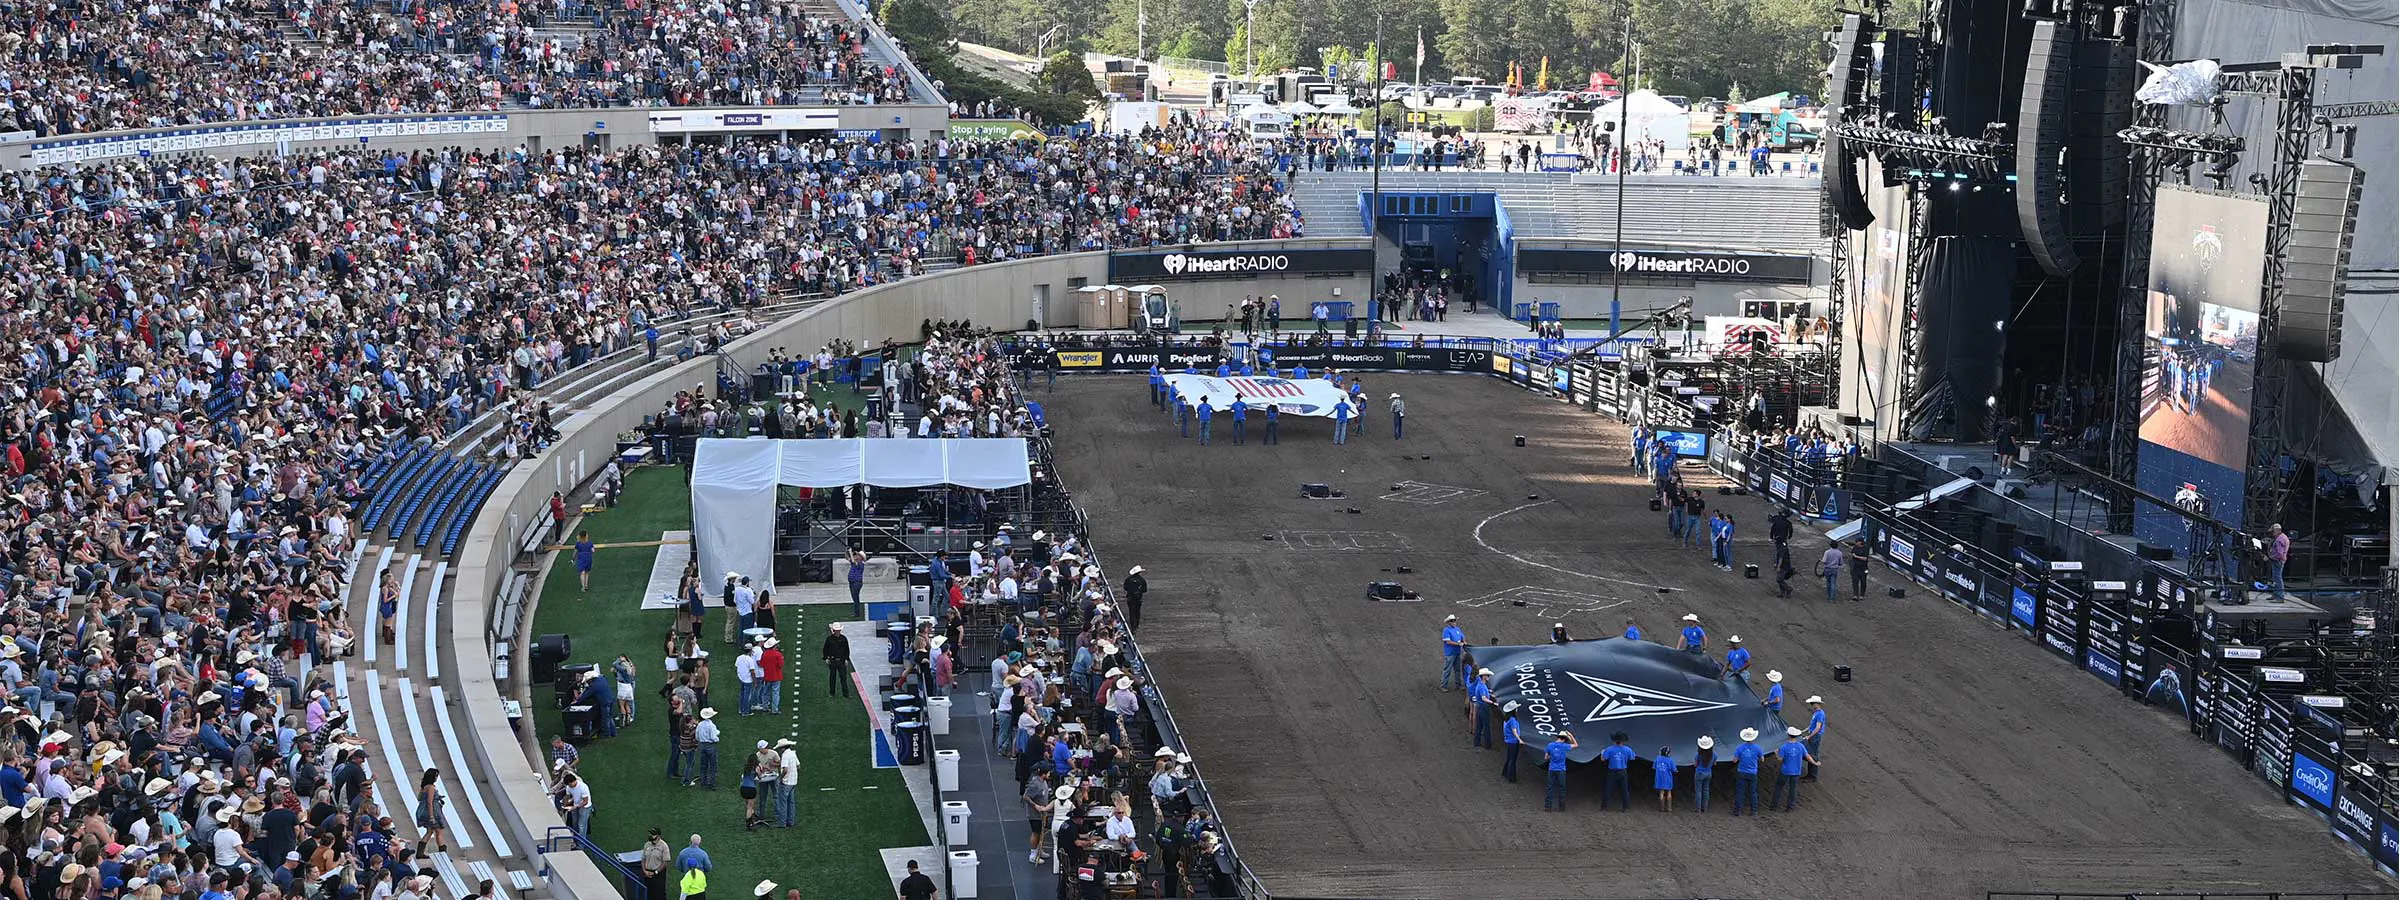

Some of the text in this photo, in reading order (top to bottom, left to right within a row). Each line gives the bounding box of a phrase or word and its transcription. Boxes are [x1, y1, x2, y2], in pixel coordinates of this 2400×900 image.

[952, 125, 1007, 135] Stop playing
[1187, 256, 1288, 272] iHeartRADIO
[1638, 256, 1750, 274] iHeartRADIO
[1061, 354, 1097, 364] Wrangler
[1127, 354, 1158, 362] AURIS
[1170, 353, 1213, 363] Priefert
[1340, 354, 1384, 362] iHeartRadio
[1450, 352, 1484, 363] LEAP
[2094, 660, 2117, 677] crypto.com
[1544, 669, 1570, 726] UNITED STATES
[2296, 768, 2328, 794] CreditOne
[2339, 795, 2373, 831] EXCHANGE
